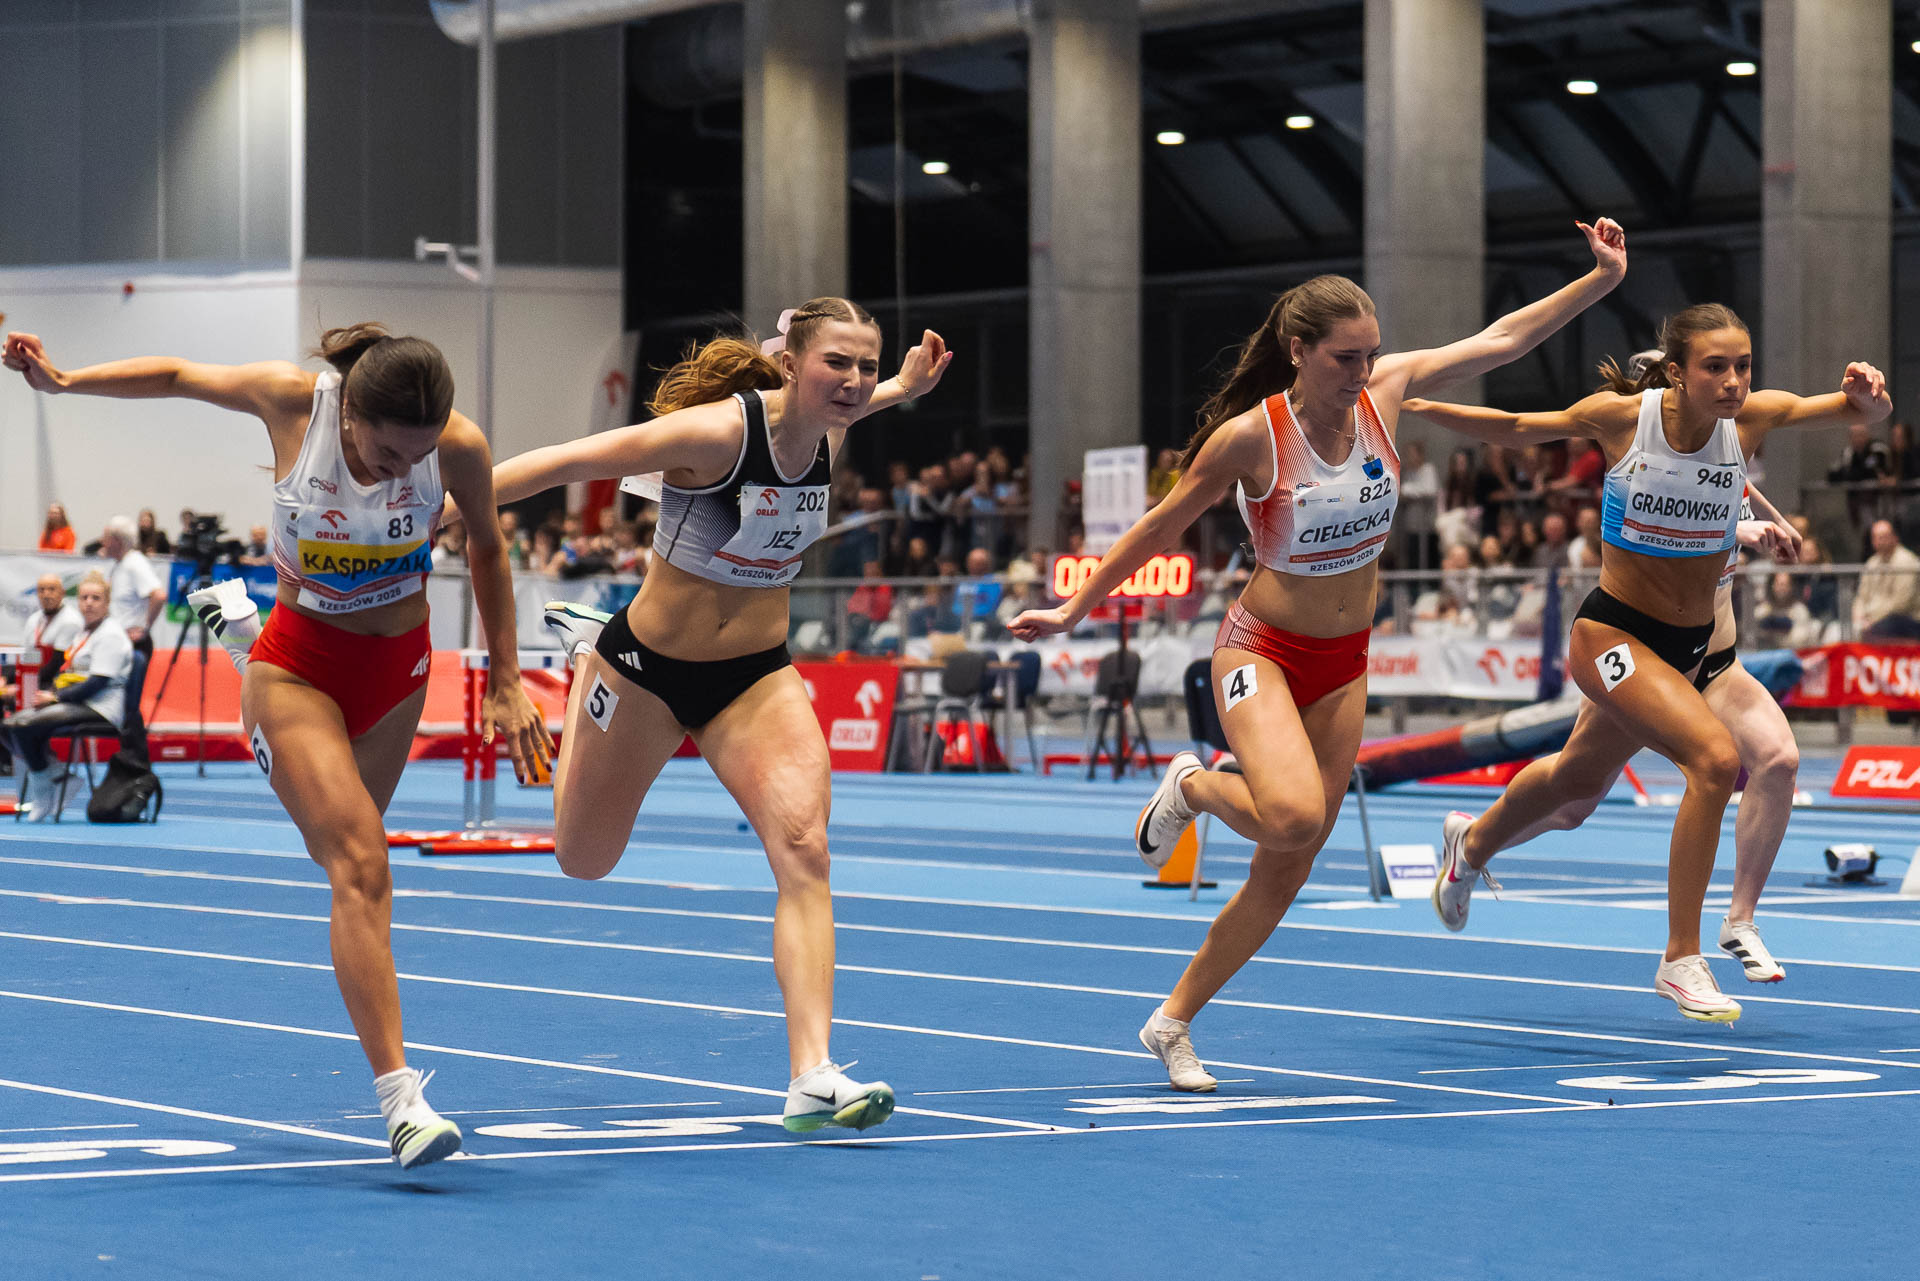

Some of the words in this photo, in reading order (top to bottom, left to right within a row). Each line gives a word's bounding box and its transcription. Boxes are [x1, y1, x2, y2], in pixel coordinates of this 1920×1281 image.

[1359, 477, 1392, 504] 822
[1697, 468, 1733, 488] 948
[755, 508, 780, 517] ORLEN
[795, 491, 825, 512] 202
[1632, 492, 1730, 521] GRABOWSKA
[315, 531, 350, 541] ORLEN
[387, 514, 413, 539] 83
[763, 525, 802, 550] JEŻ
[1298, 508, 1390, 544] CIELECKA
[1639, 534, 1684, 548] RZESZÓW
[303, 552, 427, 580] KASPRZAK
[730, 567, 775, 580] RZESZÓW
[1310, 556, 1355, 572] RZESZÓW
[318, 595, 374, 611] RZESZÓW
[1604, 651, 1626, 681] 3
[1230, 669, 1248, 700] 4
[590, 682, 610, 719] 5
[253, 737, 269, 775] 6
